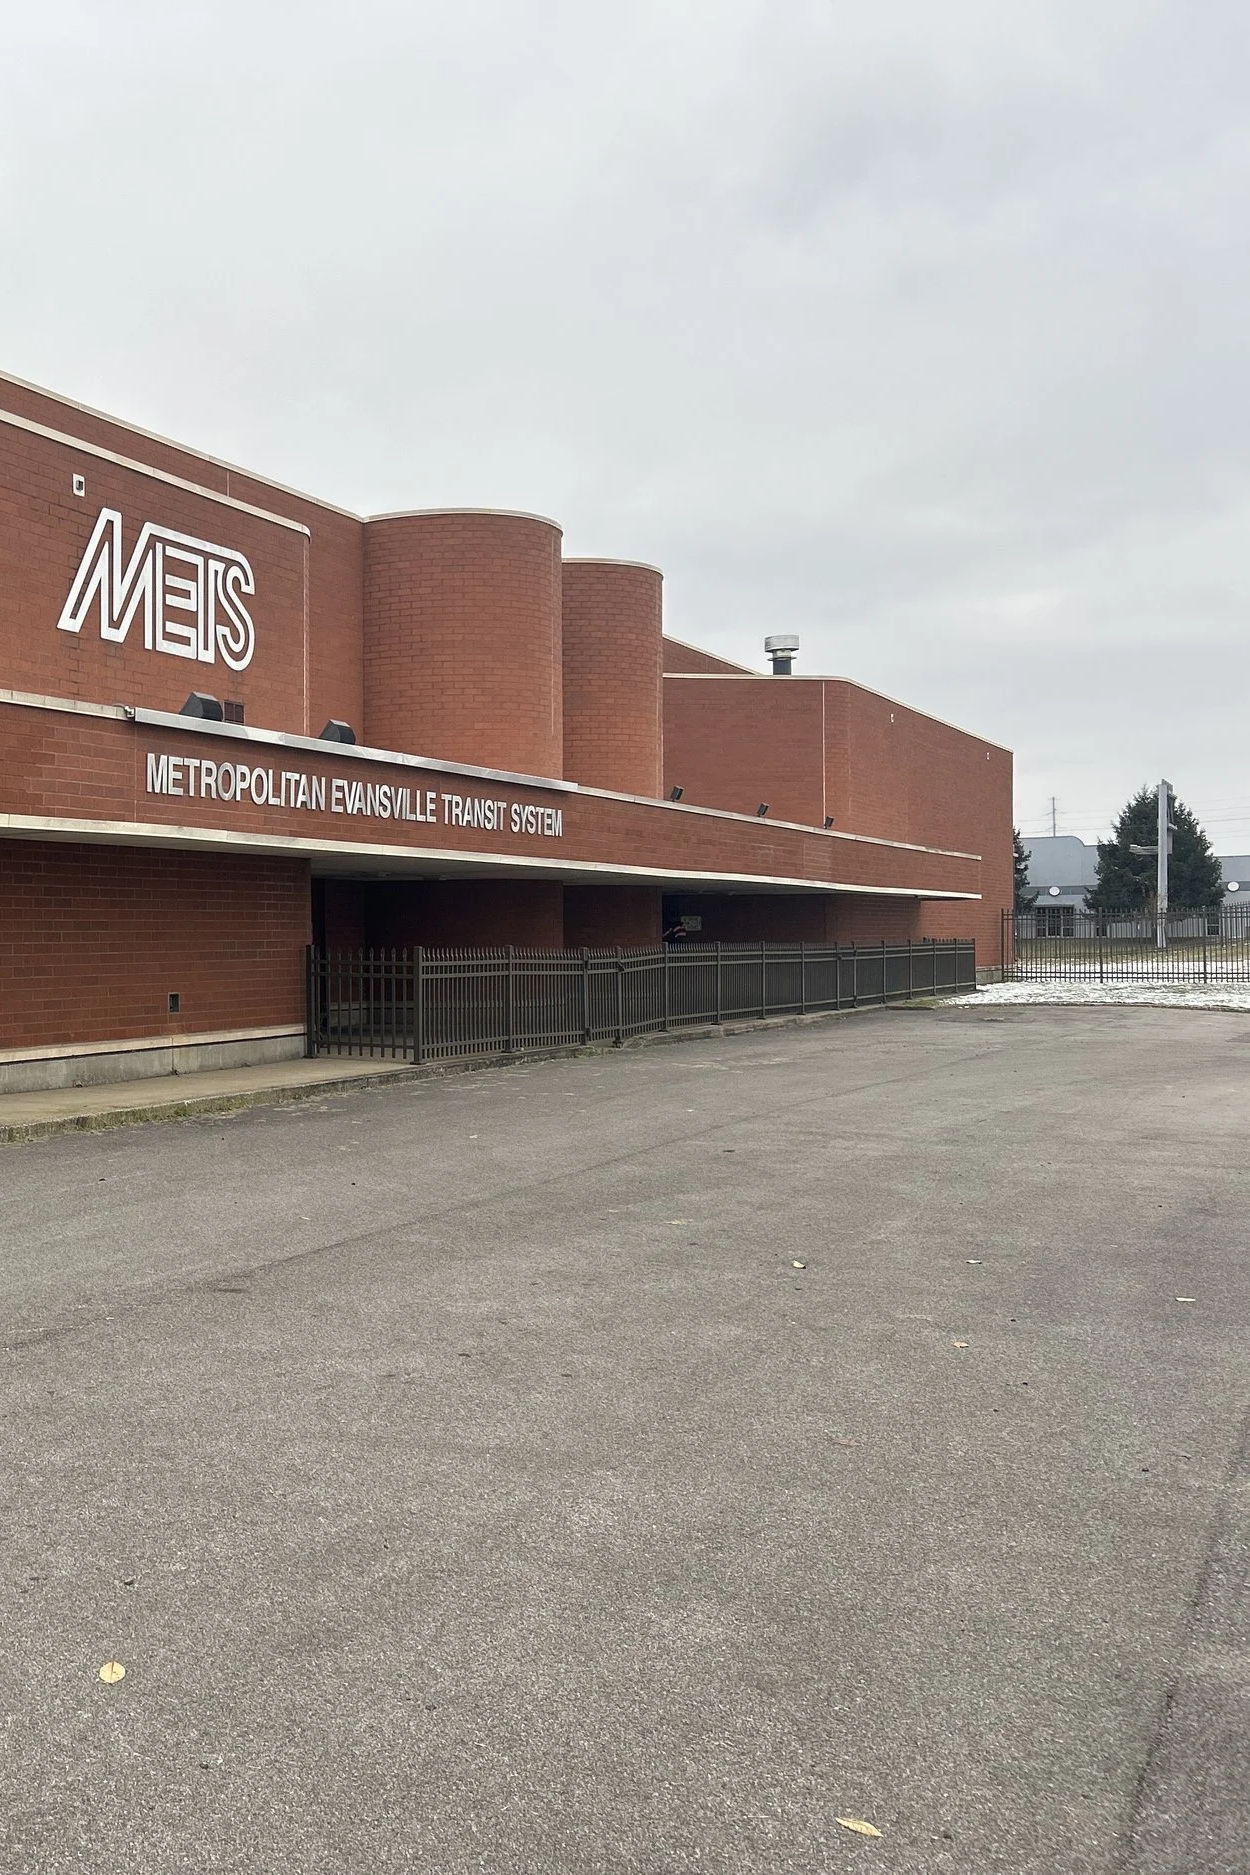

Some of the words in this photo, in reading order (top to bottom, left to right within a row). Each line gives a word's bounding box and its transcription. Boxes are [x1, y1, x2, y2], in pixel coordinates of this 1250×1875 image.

[56, 507, 255, 671] METS
[146, 753, 326, 811] METROPOLITAN
[331, 778, 437, 823] EVANSVILLE
[441, 793, 507, 831] TRANSIT
[510, 803, 563, 837] SYSTEM
